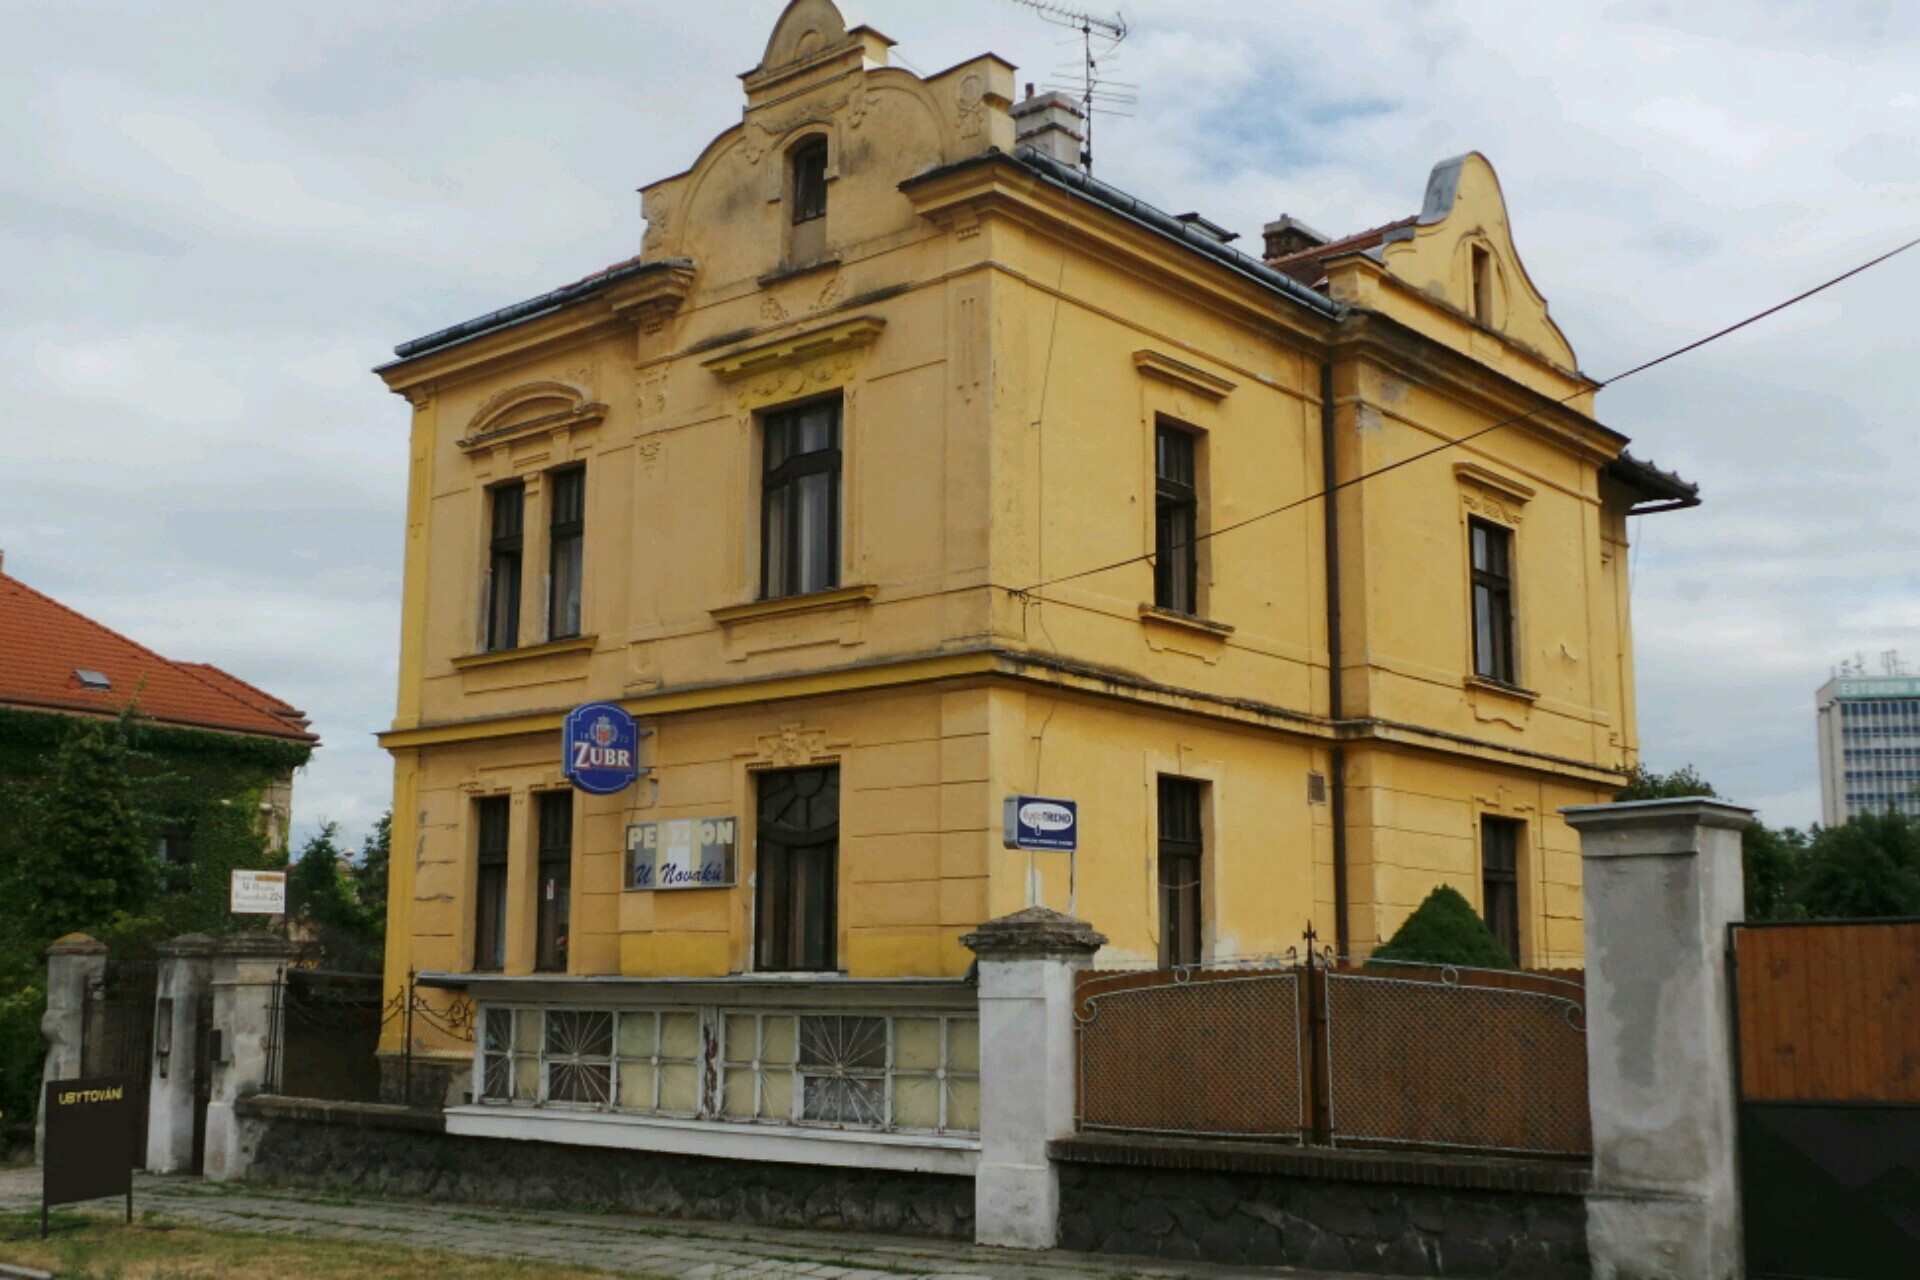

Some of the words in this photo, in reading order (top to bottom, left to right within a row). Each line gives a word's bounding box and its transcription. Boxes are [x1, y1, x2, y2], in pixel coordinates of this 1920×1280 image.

[574, 741, 632, 769] ZUBR
[627, 821, 734, 850] PEZON
[635, 863, 653, 884] U
